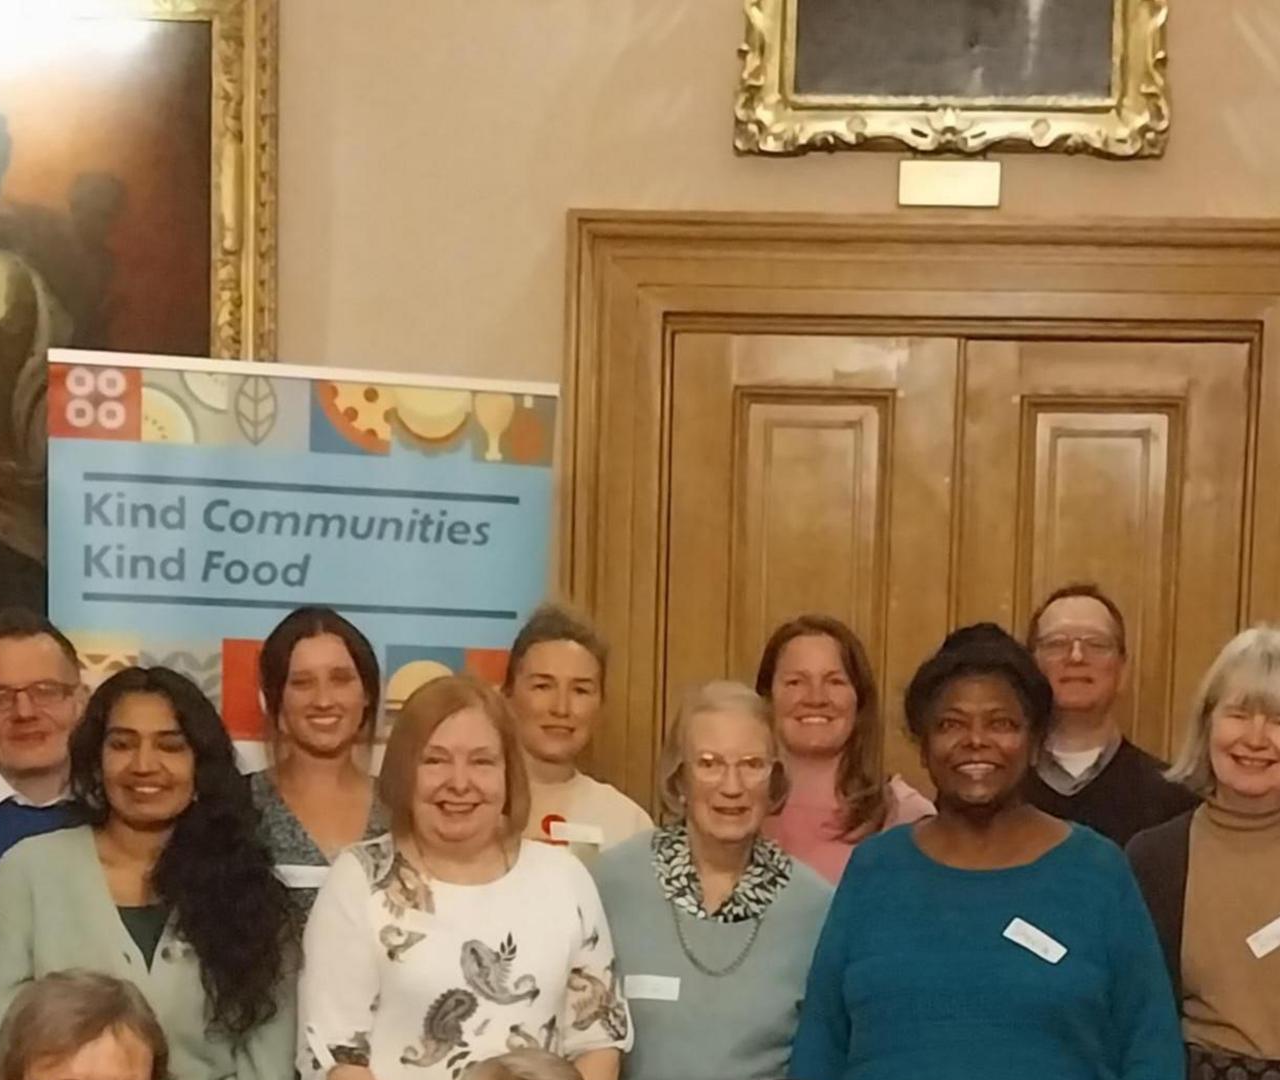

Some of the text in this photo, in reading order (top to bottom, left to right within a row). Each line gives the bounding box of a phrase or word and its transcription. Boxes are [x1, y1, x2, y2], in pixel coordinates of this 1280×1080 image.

[83, 492, 492, 548] Kind Communities
[83, 543, 312, 588] Kind Food
